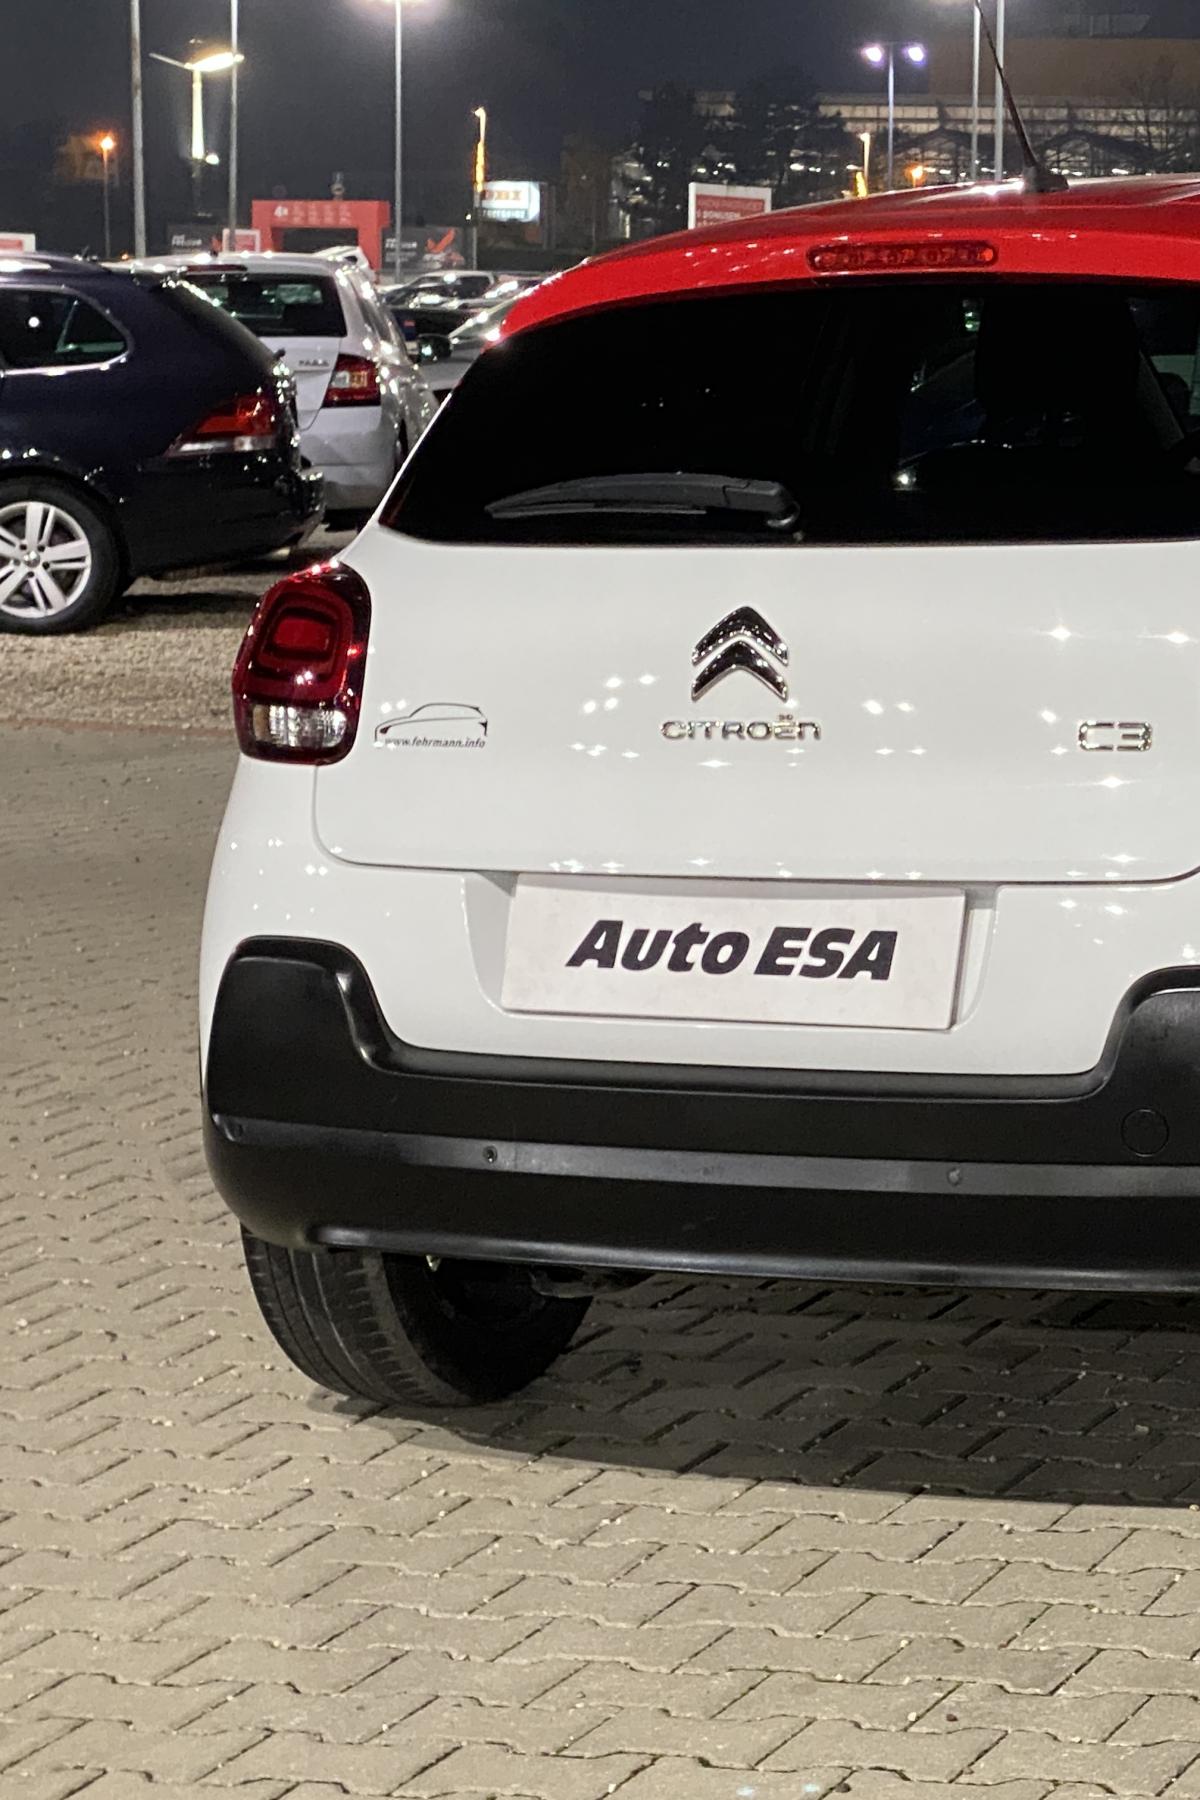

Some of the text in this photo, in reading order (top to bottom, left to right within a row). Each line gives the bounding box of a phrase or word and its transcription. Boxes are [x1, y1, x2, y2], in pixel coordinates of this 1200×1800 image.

[1078, 721, 1152, 752] C3
[565, 920, 898, 980] Auto ESA
